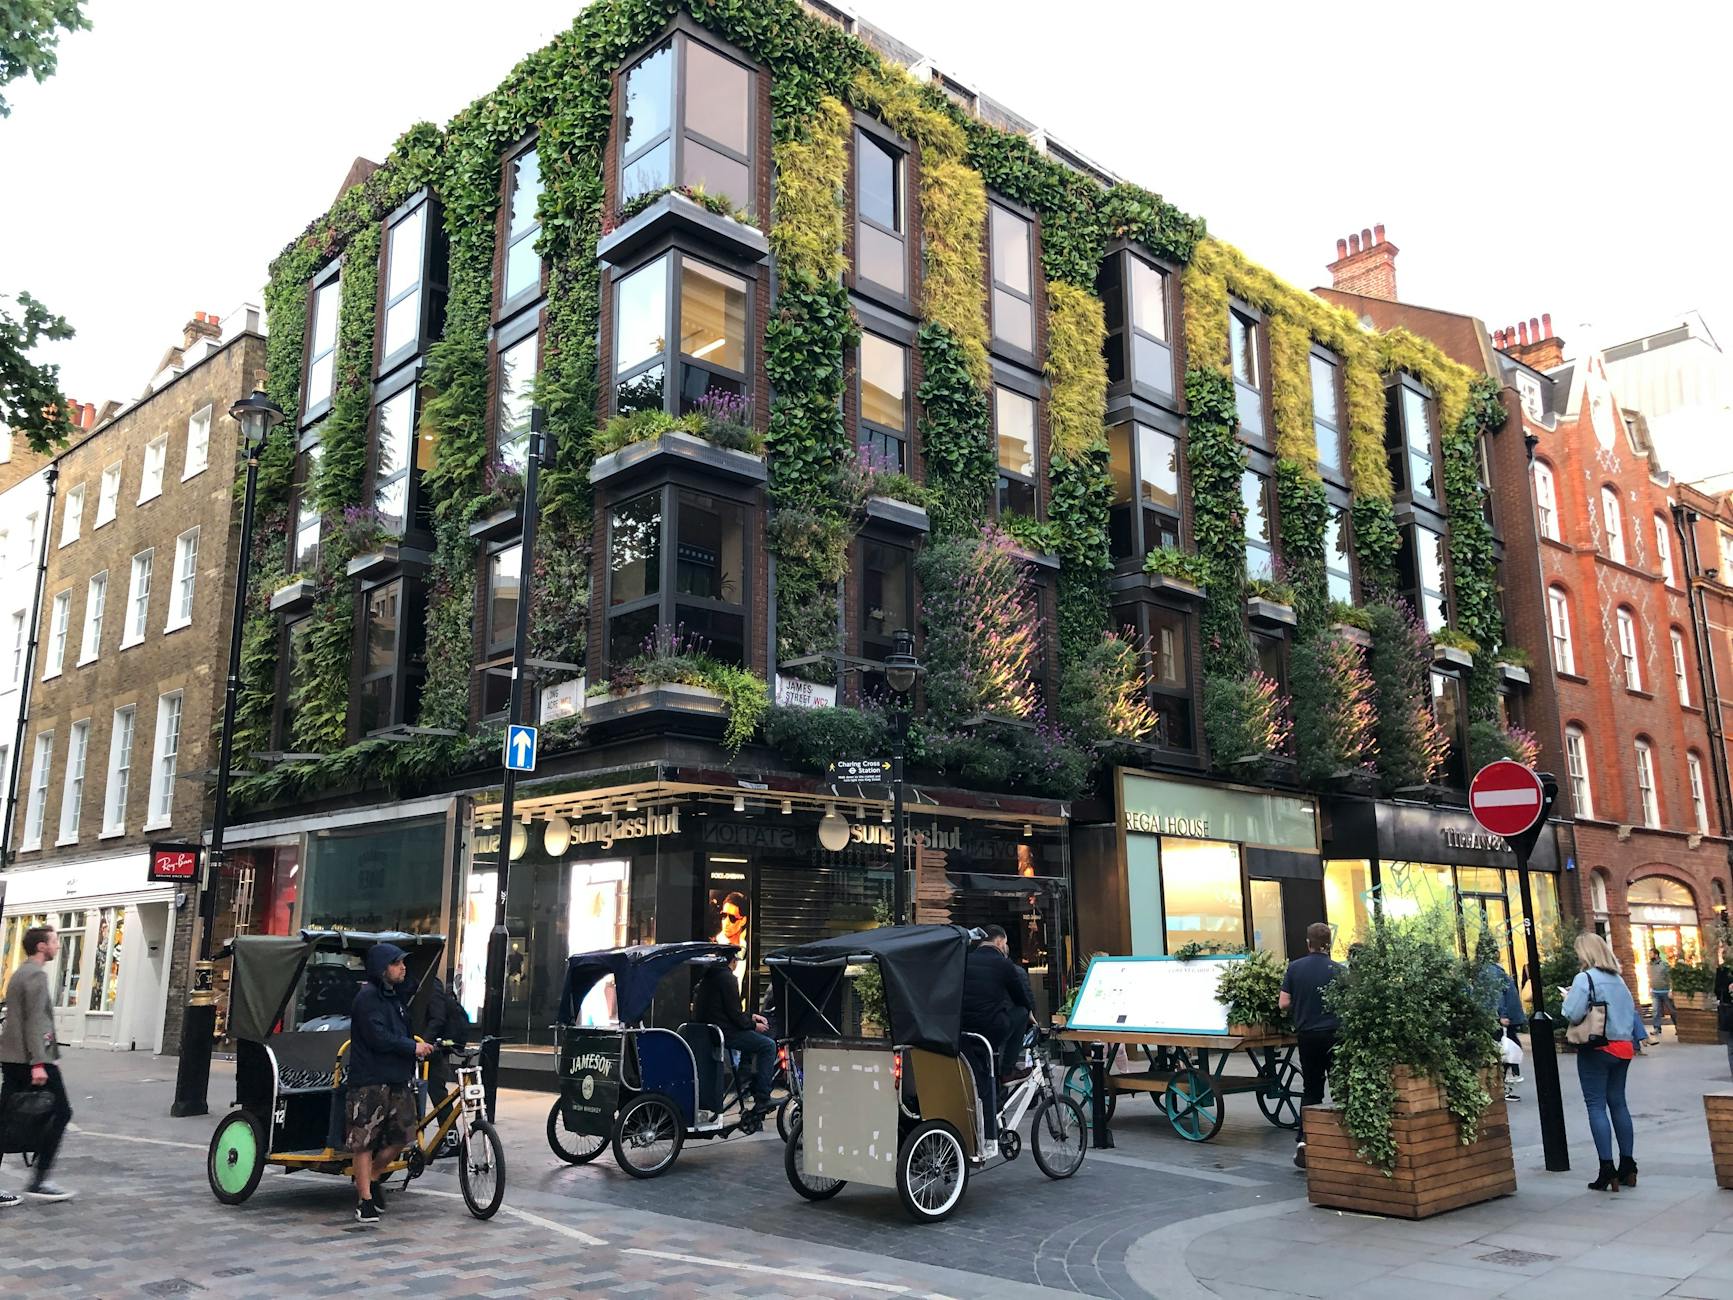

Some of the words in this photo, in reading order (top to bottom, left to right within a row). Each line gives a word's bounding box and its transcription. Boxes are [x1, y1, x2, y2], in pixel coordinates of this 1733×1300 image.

[786, 681, 812, 694] JAMES
[785, 692, 811, 704] STREET
[1125, 811, 1164, 833] REGAL
[1167, 816, 1209, 838] HOUSE
[157, 853, 193, 872] Ray-Ban
[569, 1053, 612, 1077] JAMESON
[274, 1110, 285, 1124] 12
